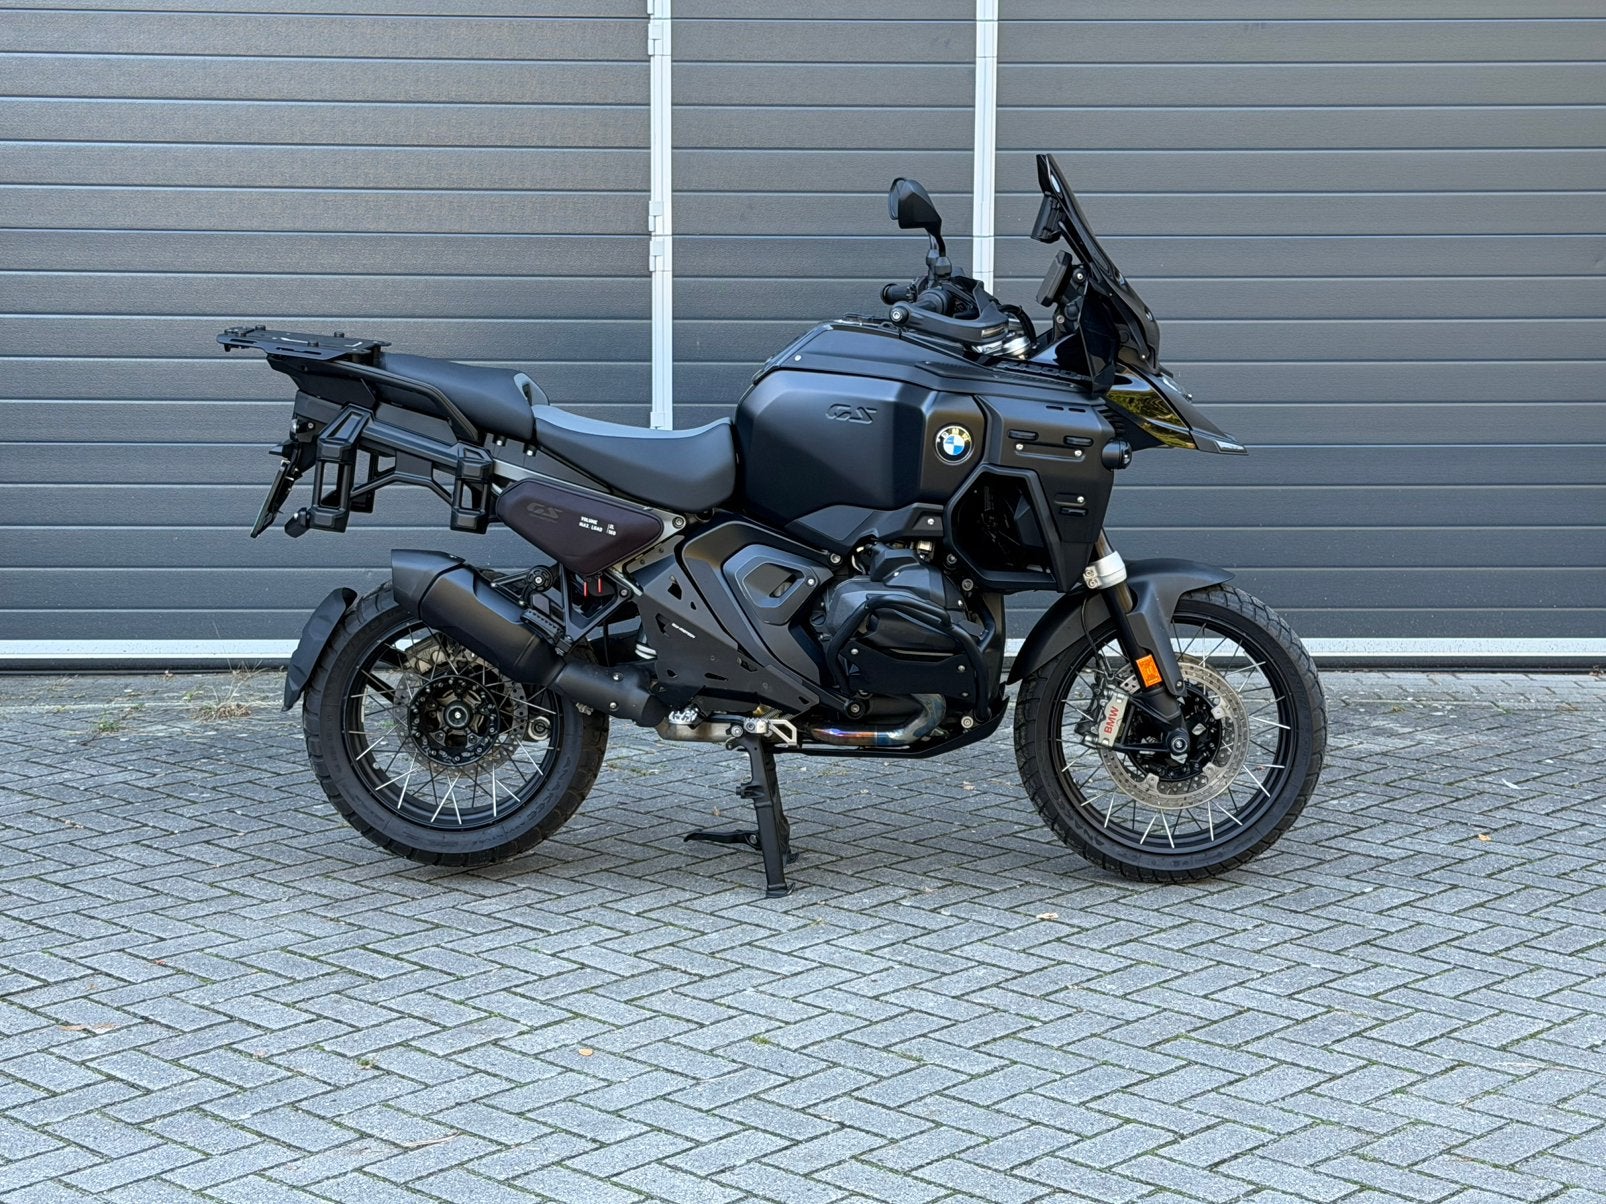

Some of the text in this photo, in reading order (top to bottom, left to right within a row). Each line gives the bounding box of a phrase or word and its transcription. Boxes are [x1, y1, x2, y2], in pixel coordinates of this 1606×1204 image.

[825, 403, 877, 424] GS
[526, 502, 563, 519] GS
[1104, 706, 1119, 734] BMW
